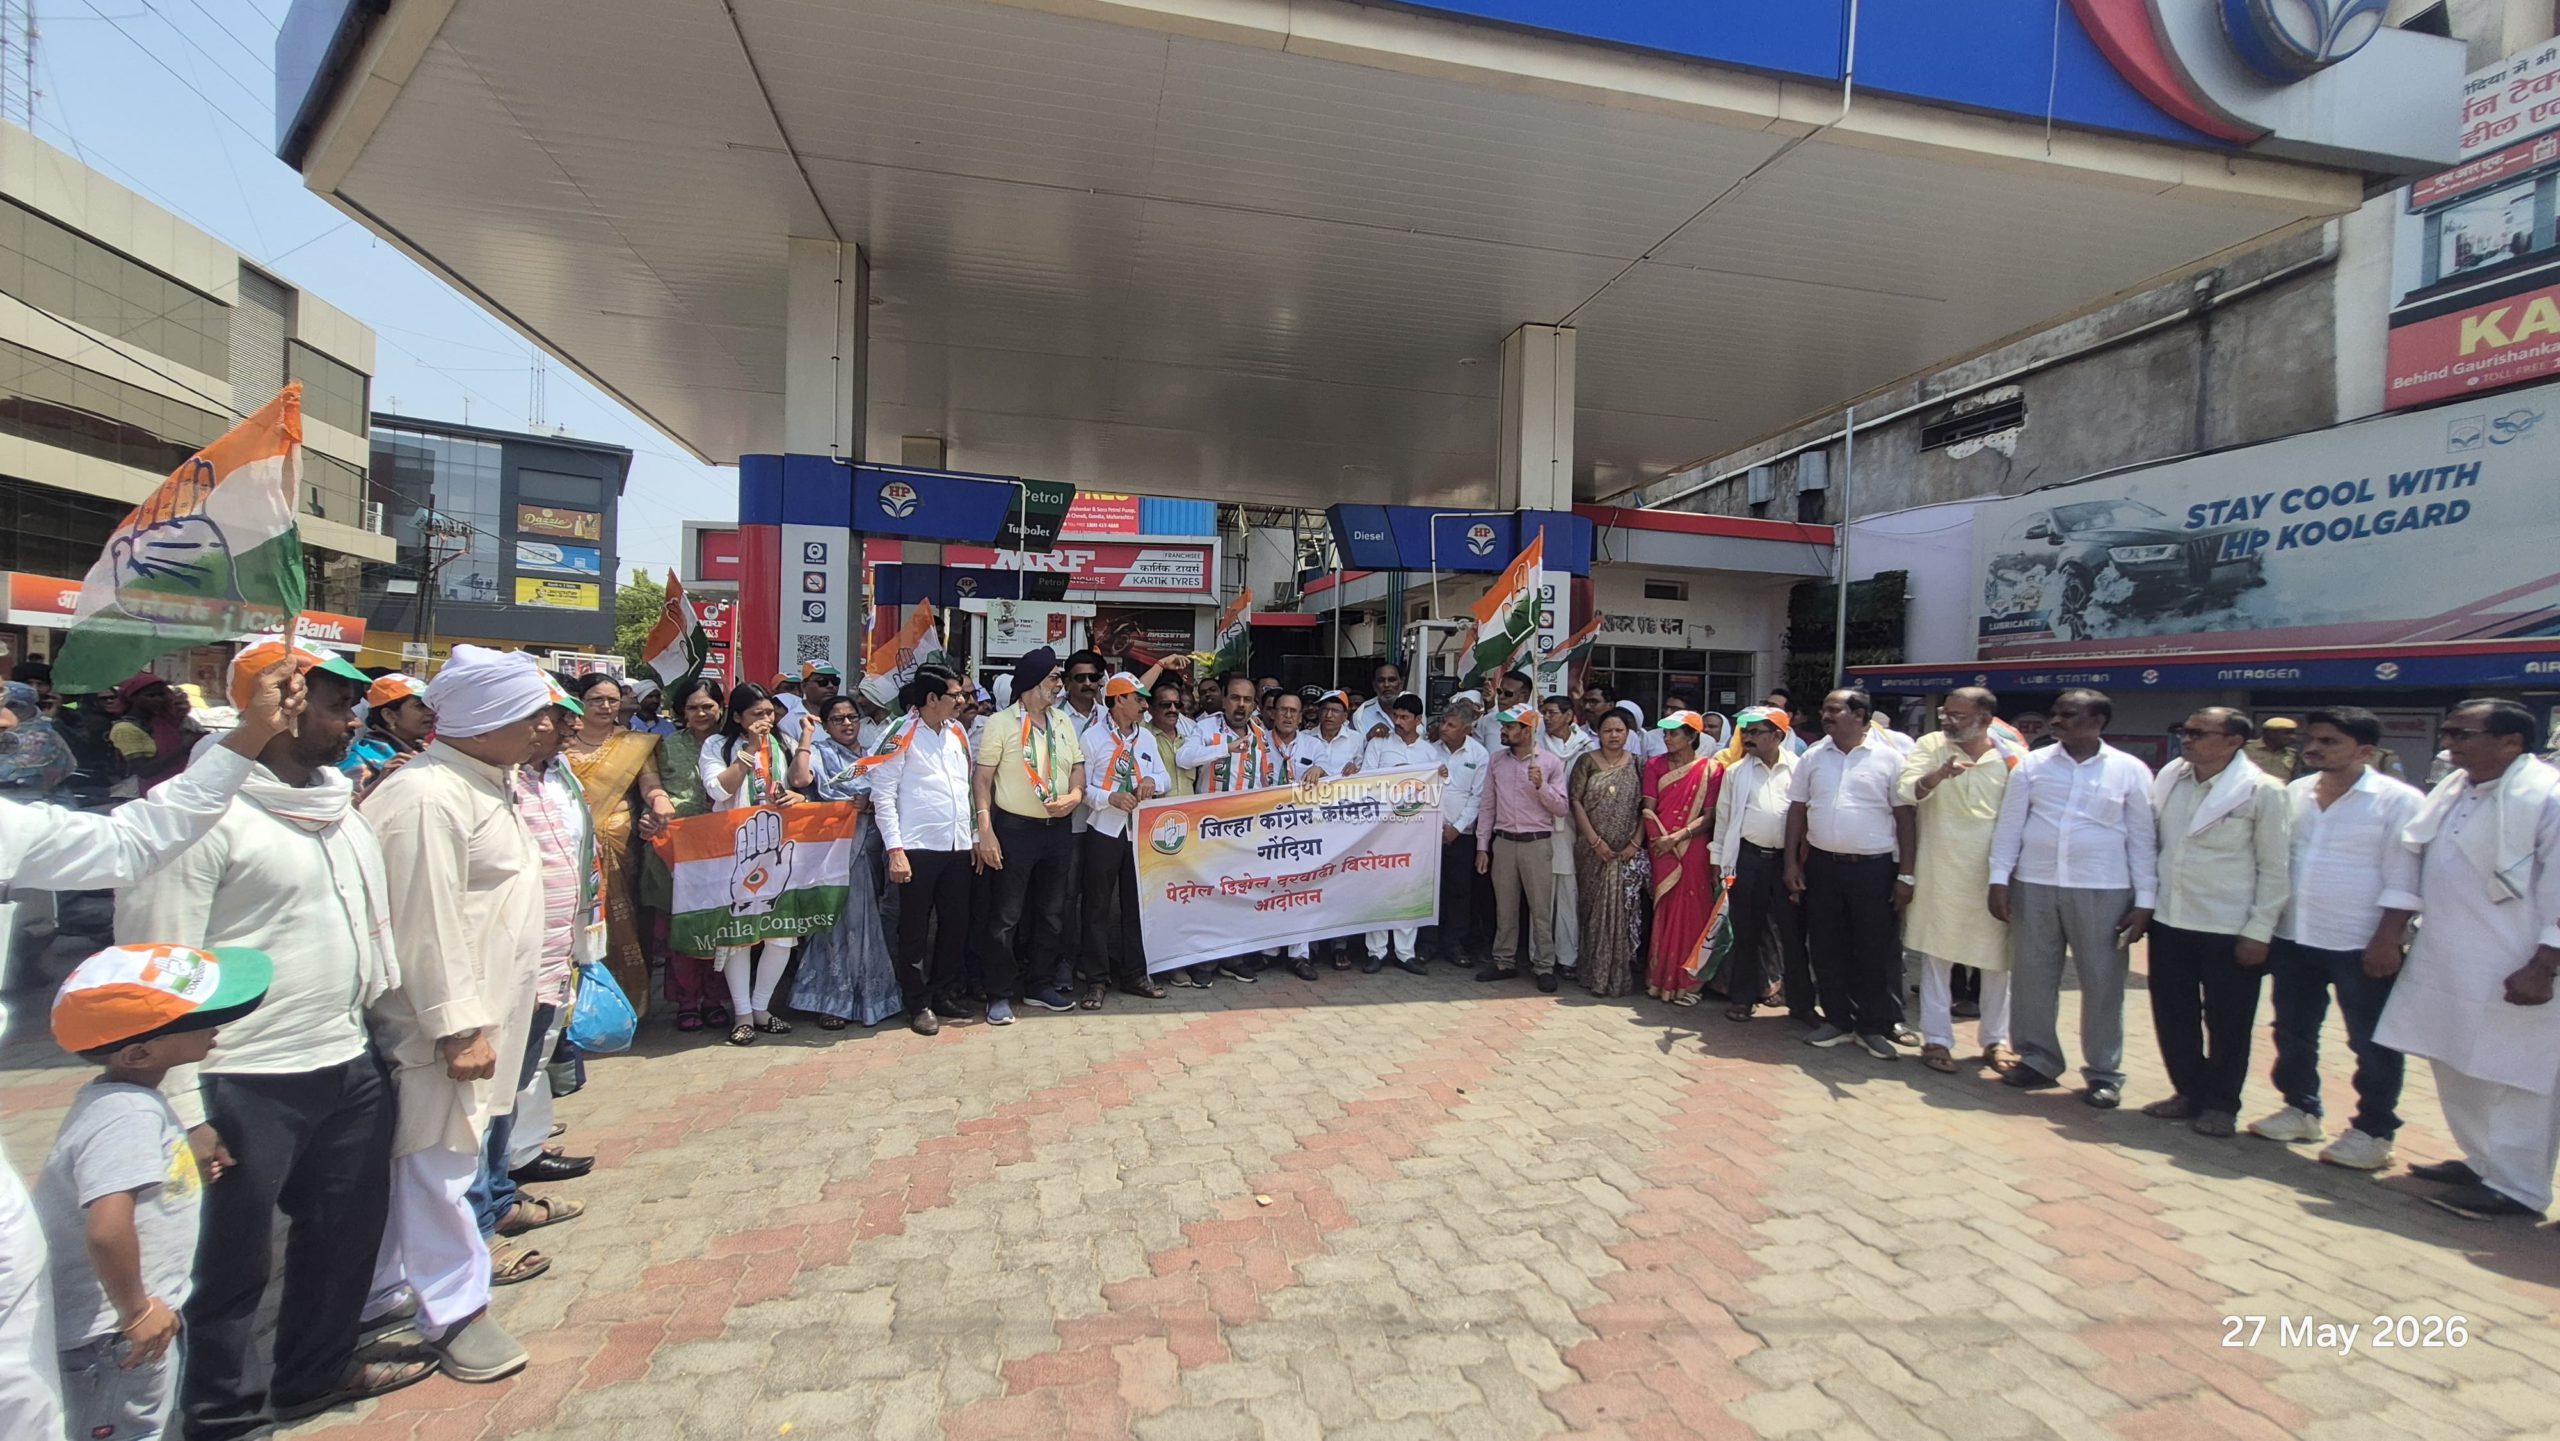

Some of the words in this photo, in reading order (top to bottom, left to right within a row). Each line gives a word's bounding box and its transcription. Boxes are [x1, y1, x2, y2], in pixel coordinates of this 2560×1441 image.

[2392, 366, 2449, 390] Behind
[888, 485, 911, 498] HP
[1024, 489, 1064, 505] Petrol
[2184, 492, 2276, 530] STAY
[2280, 478, 2376, 514] COOL
[2388, 461, 2482, 498] WITH
[524, 513, 567, 526] Dazzle
[1007, 523, 1050, 537] TuboJet
[1353, 531, 1384, 541] Diesel
[1473, 527, 1491, 538] HP
[2220, 528, 2271, 559] HP
[2275, 500, 2471, 551] KOOLGARD
[990, 548, 1096, 573] MRF
[1038, 577, 1065, 586] Petrol
[1132, 576, 1168, 585] KARTIK
[1170, 576, 1200, 586] TYRES
[294, 616, 344, 640] Bank
[1988, 618, 2041, 631] LUBRICANTS
[2020, 674, 2051, 685] LUBE
[2056, 673, 2110, 684] STATION
[2217, 668, 2300, 680] NITROGEN
[1200, 817, 1254, 838] जिल्हा
[1257, 836, 1323, 861] गोंदिया
[1166, 880, 1215, 904] पेट्रोल
[1341, 850, 1412, 873] विरोधात
[1254, 888, 1323, 912] आंदोलन
[759, 912, 835, 934] Congress
